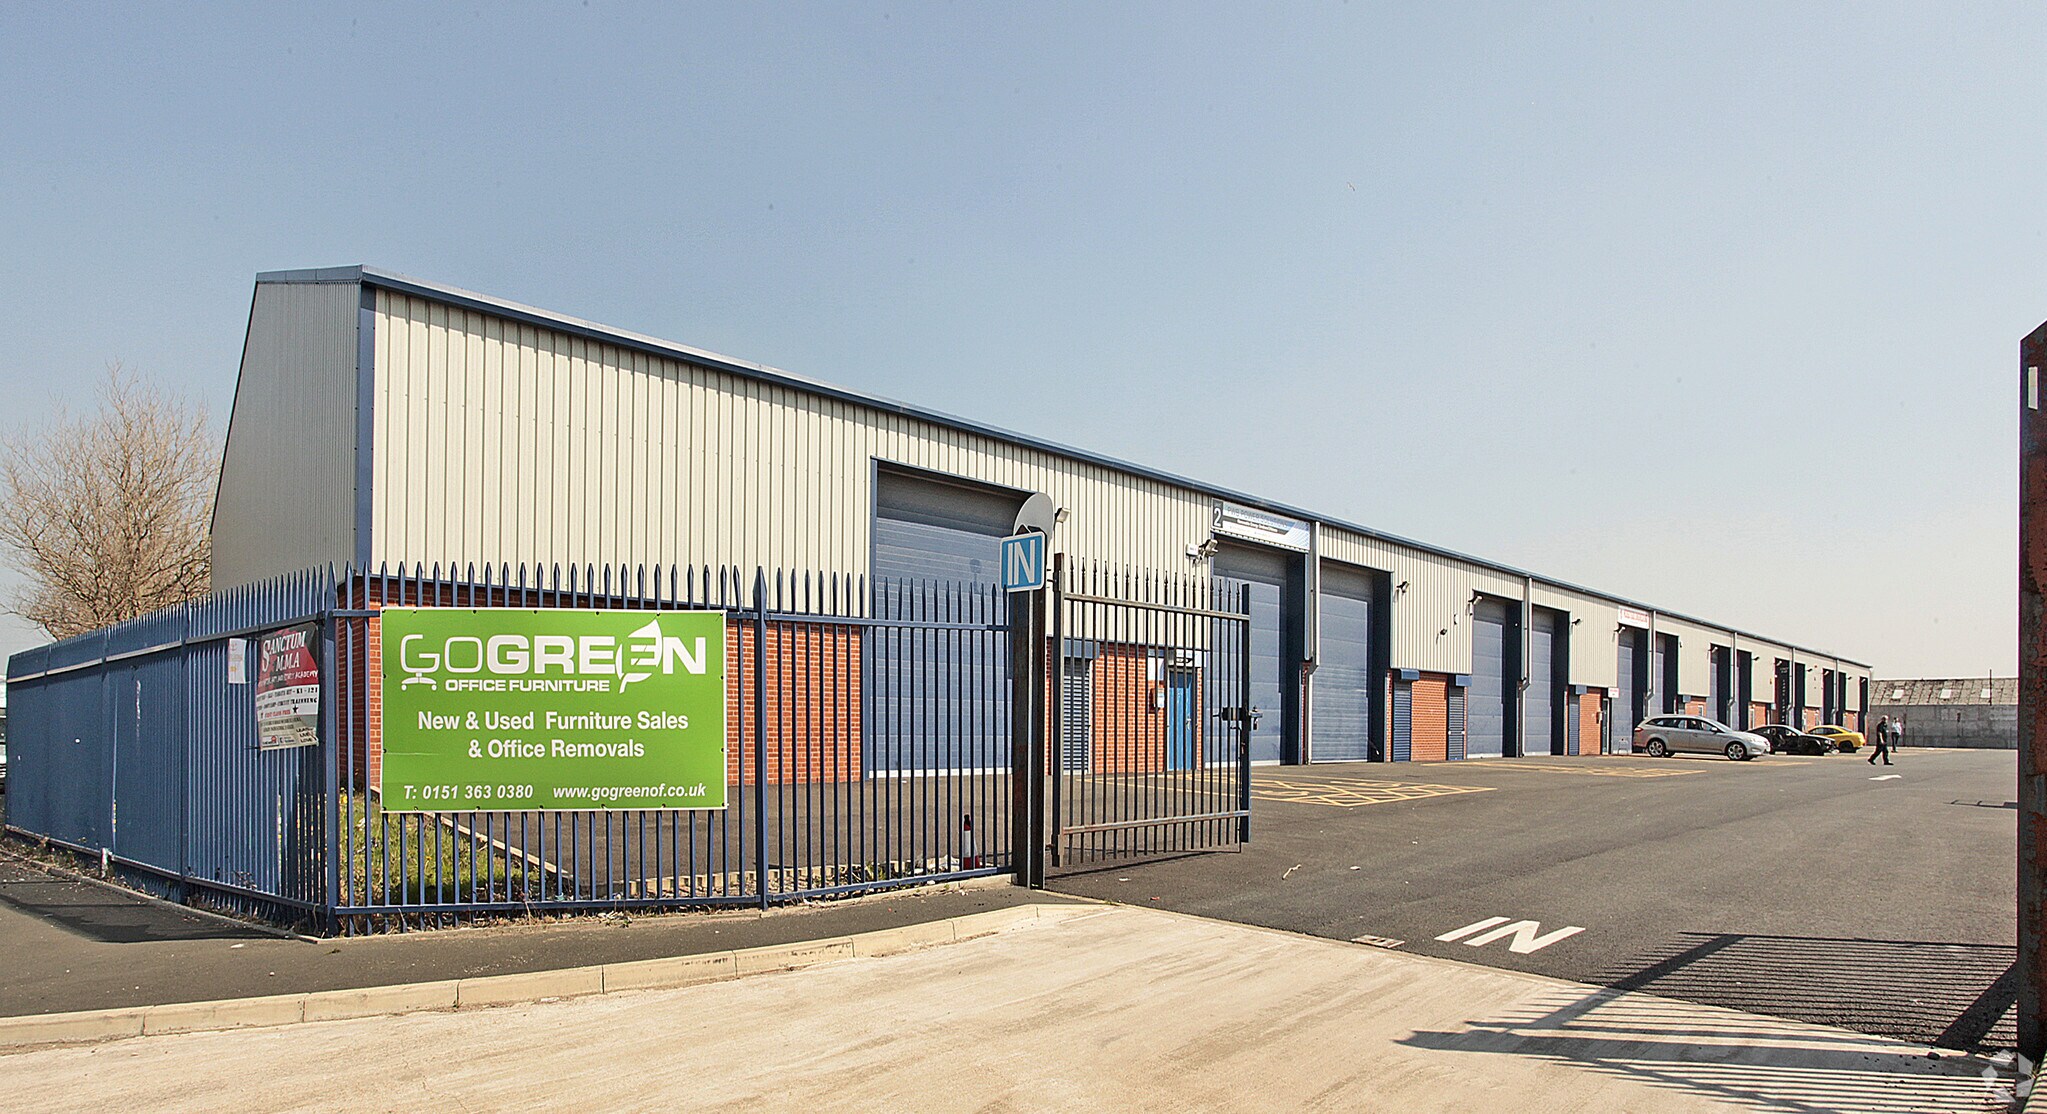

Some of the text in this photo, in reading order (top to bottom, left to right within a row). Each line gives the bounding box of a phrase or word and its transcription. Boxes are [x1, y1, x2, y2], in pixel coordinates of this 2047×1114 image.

[1213, 507, 1221, 527] 2
[1007, 539, 1036, 586] IN
[262, 631, 307, 672] SANCTUM
[445, 679, 610, 693] OFFICE FURNITURE
[418, 711, 689, 730] New & Used Furniture Sales
[468, 739, 645, 758] & Office Removals
[404, 783, 706, 801] T: 0151 363 0380 www.gogreenof.co.uk
[1434, 916, 1586, 955] IN
